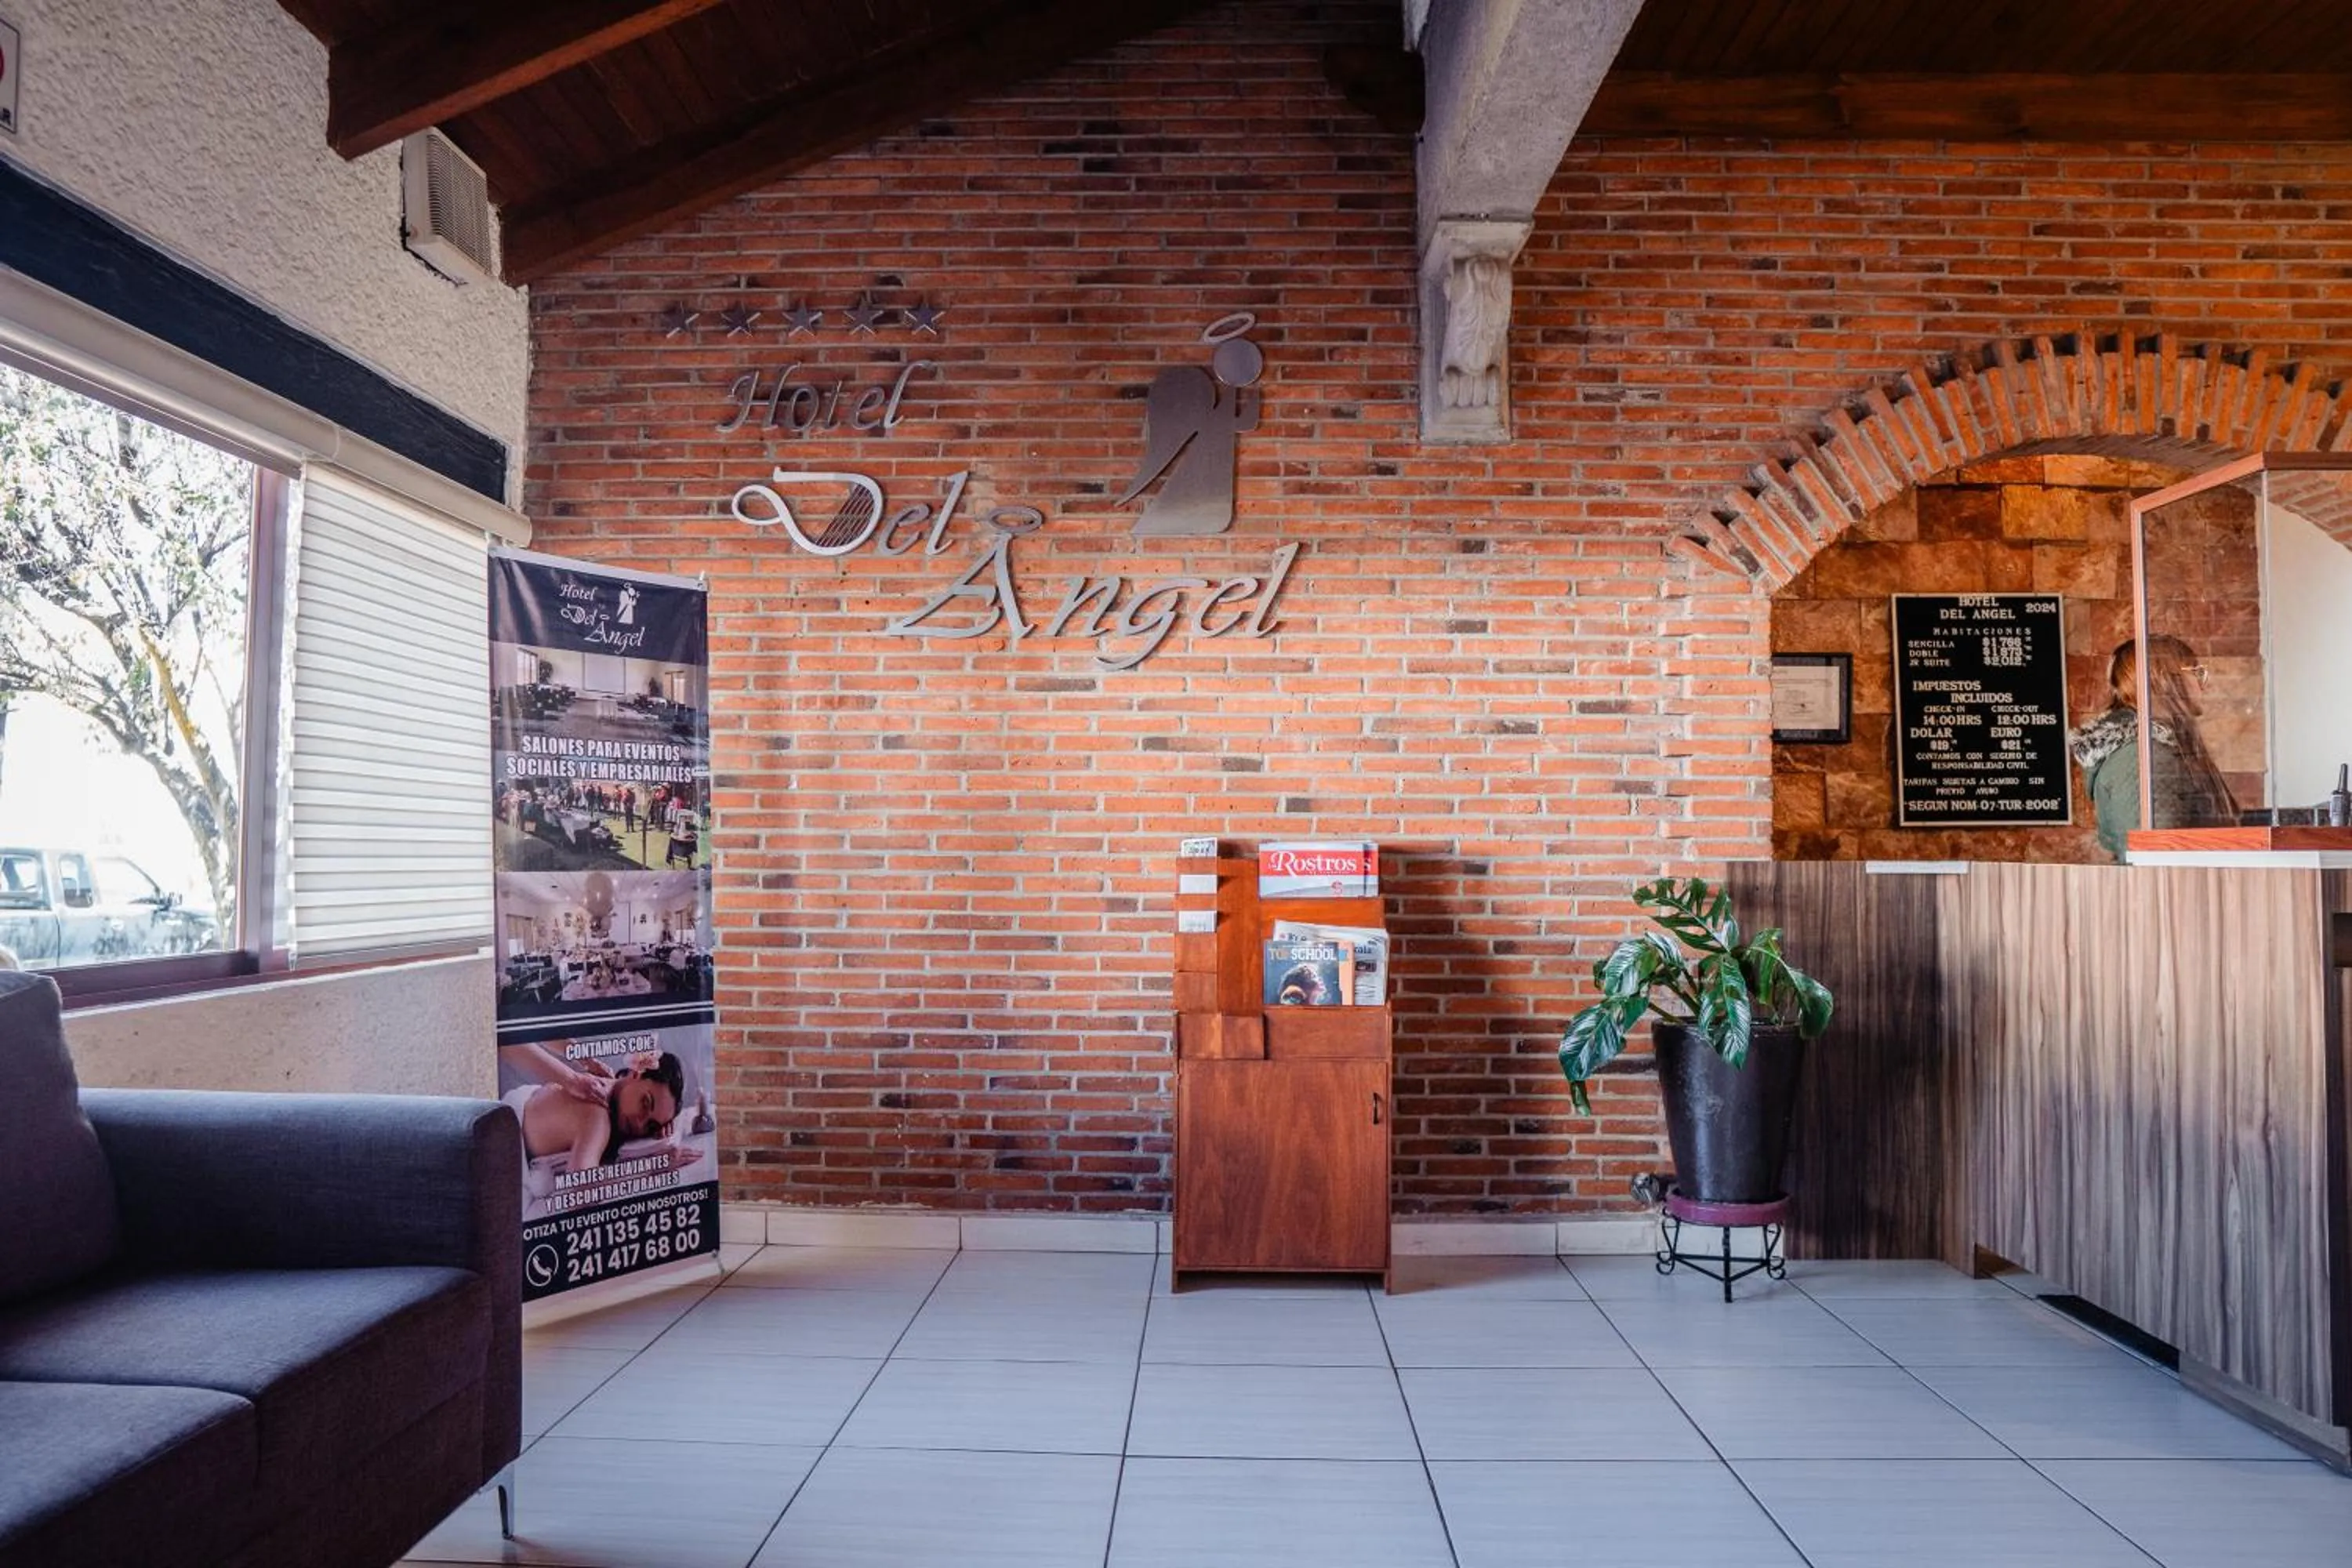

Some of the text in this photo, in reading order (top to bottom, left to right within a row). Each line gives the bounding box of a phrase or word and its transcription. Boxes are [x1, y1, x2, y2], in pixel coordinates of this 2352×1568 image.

[717, 360, 938, 433] Hotel
[731, 466, 970, 557] Del
[559, 583, 598, 602] Hotel
[1958, 597, 1999, 607] HOTEL
[560, 604, 598, 625] Del
[1940, 608, 2016, 619] DEL ANGEL
[2025, 602, 2057, 613] 2024
[1933, 627, 2031, 636] HABITACIONES
[1907, 640, 1955, 648] SENCILLA
[1912, 681, 1982, 691] IMPUESTOS
[1951, 693, 2013, 703] INCLUIDOS
[1957, 714, 1982, 725] HRS
[2031, 714, 2057, 725] HRS
[1910, 728, 1953, 738] DOLAR
[1991, 728, 2022, 738] EURO
[522, 735, 681, 761] SALONES PARA EVENTOS
[506, 755, 693, 783] SOCIALES Y EMPRESARIALES
[1270, 851, 1357, 877] Rostros
[1290, 947, 1338, 961] SCHOOL
[565, 1038, 626, 1061] CONTAMOS
[555, 1154, 670, 1190] MASAJES RELAJANTES
[546, 1170, 680, 1211] Y DESCONTRACTURANTES
[523, 1188, 709, 1241] OTIZA TU EVENTO CON NOSOTROS!
[566, 1203, 701, 1255] 241 135 45 82
[567, 1229, 701, 1283] 241 417 68 00
